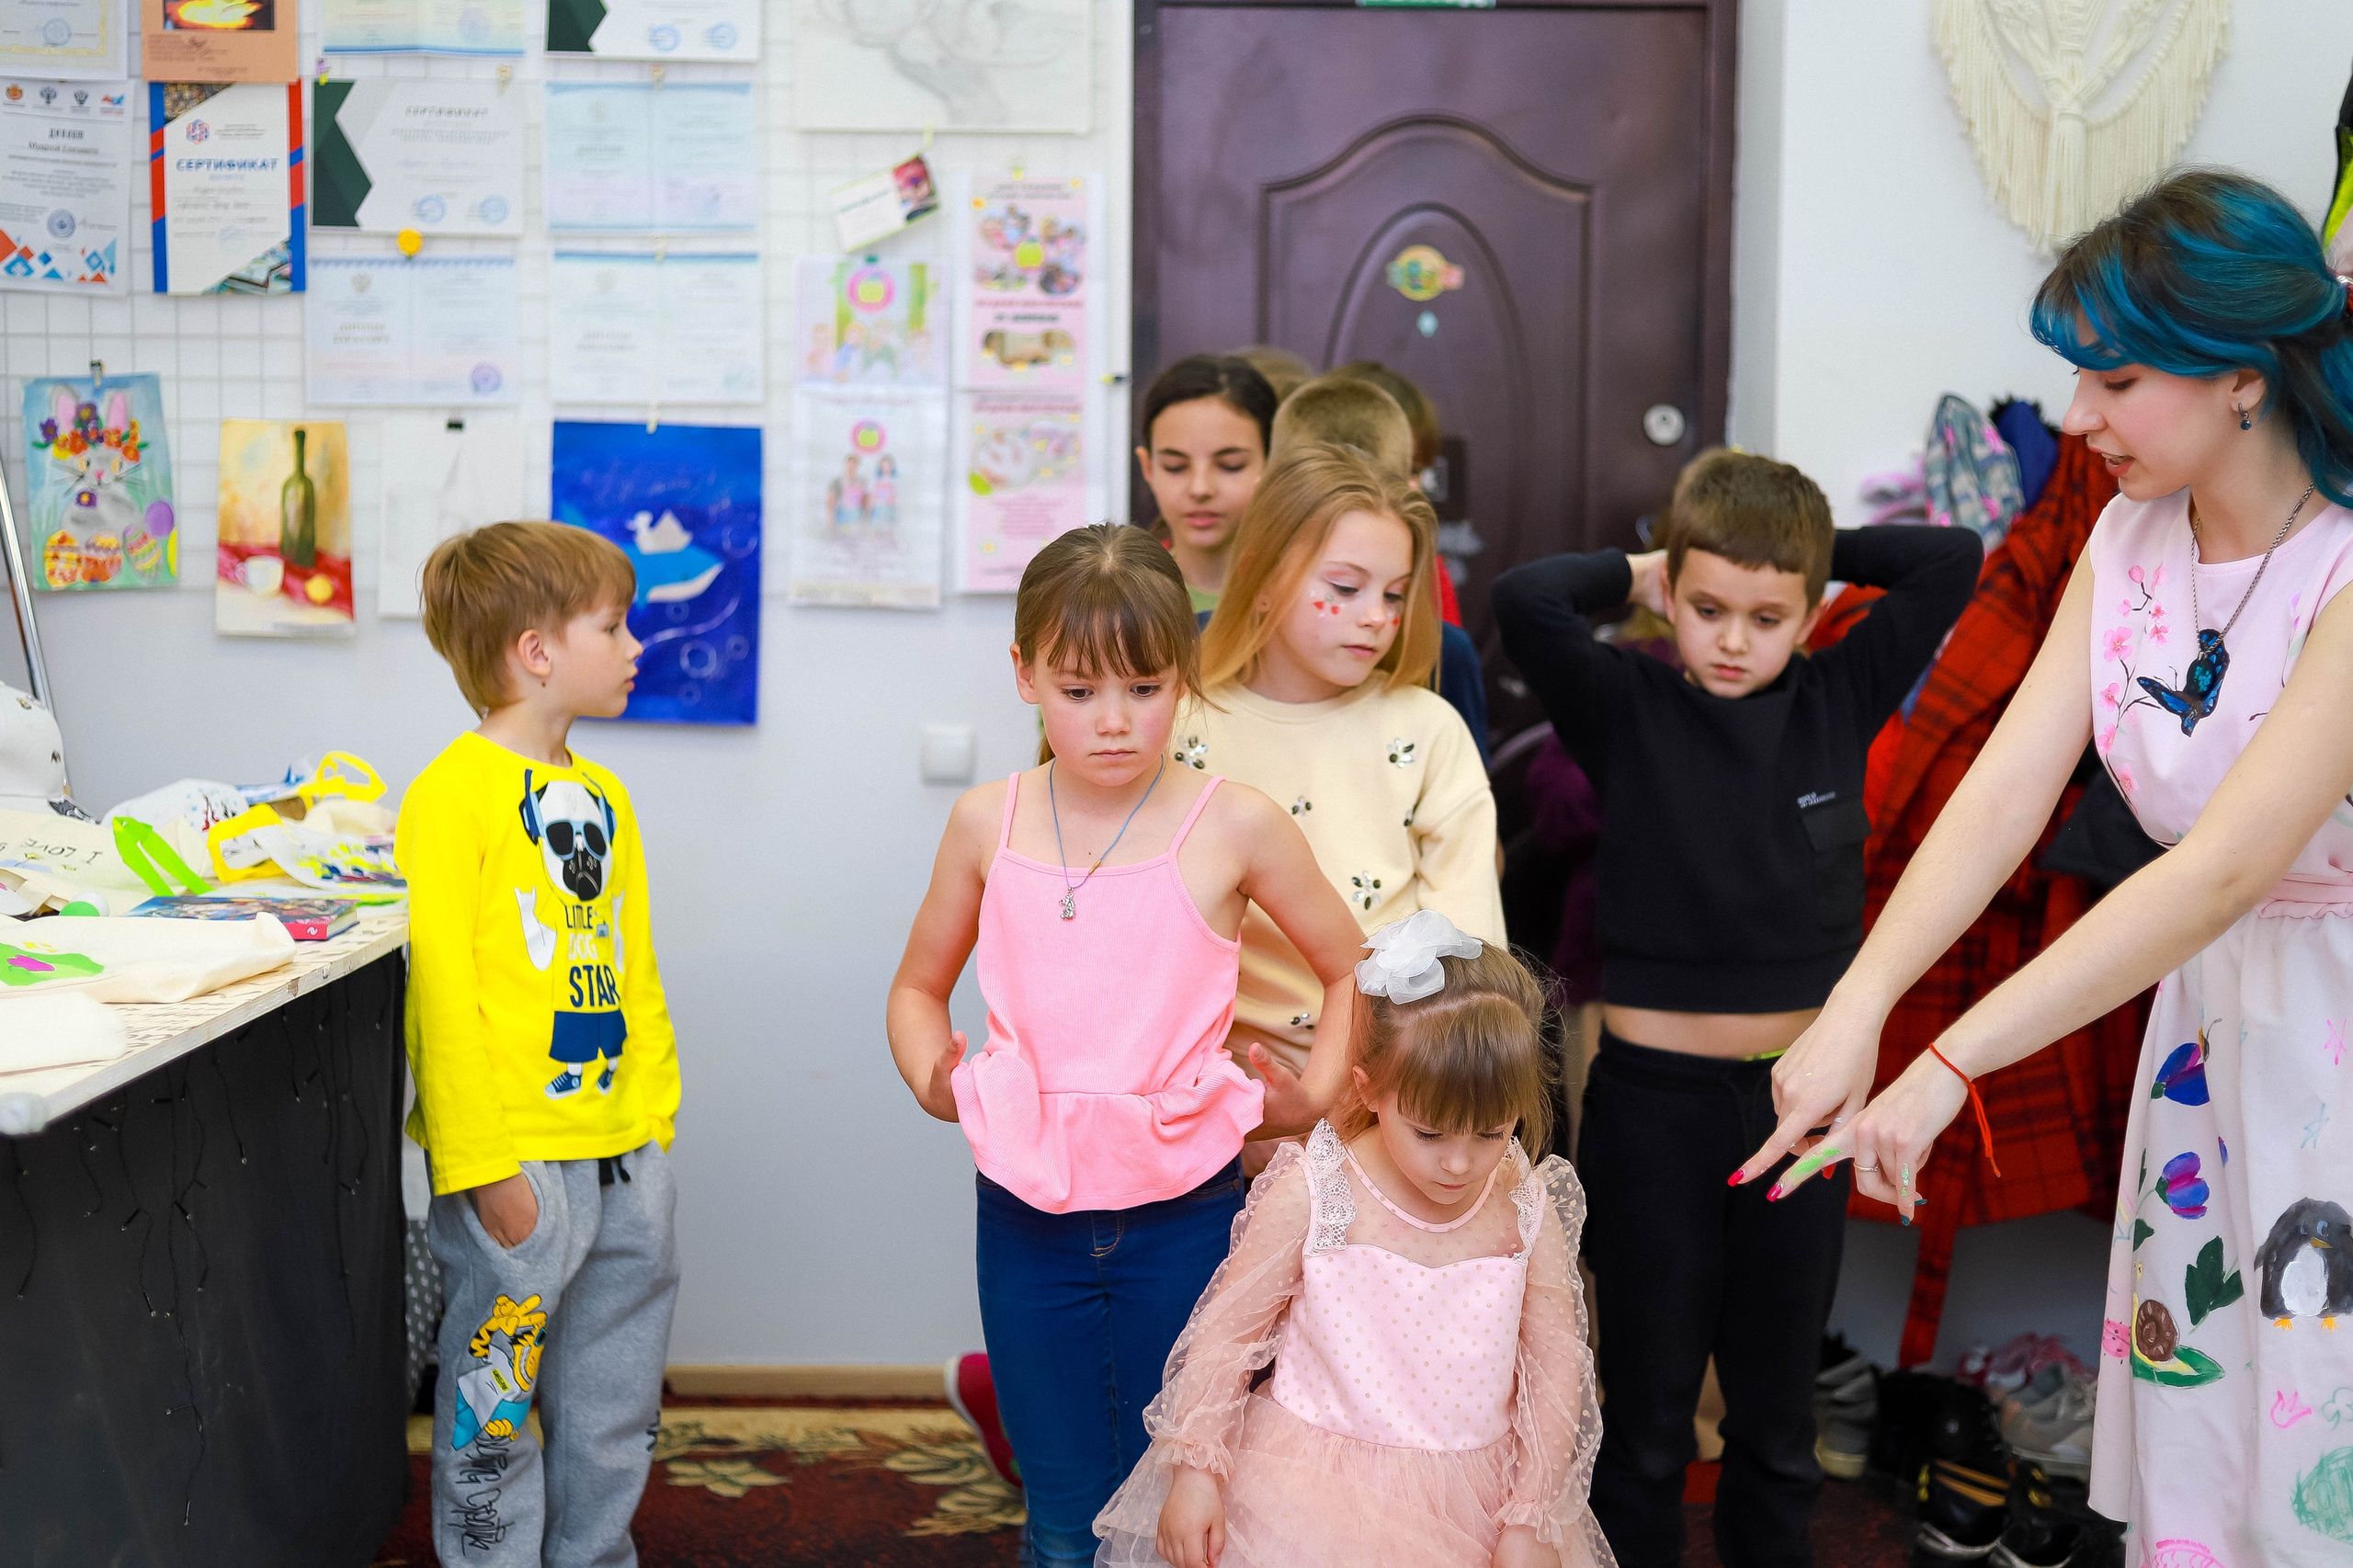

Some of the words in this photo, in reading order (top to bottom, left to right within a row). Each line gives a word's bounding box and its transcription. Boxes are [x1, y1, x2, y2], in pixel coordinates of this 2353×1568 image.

[176, 157, 279, 172] СЕРТИФИКАТ
[21, 838, 76, 858] LOVE
[569, 933, 597, 960] DOG
[570, 965, 620, 1007] STAR
